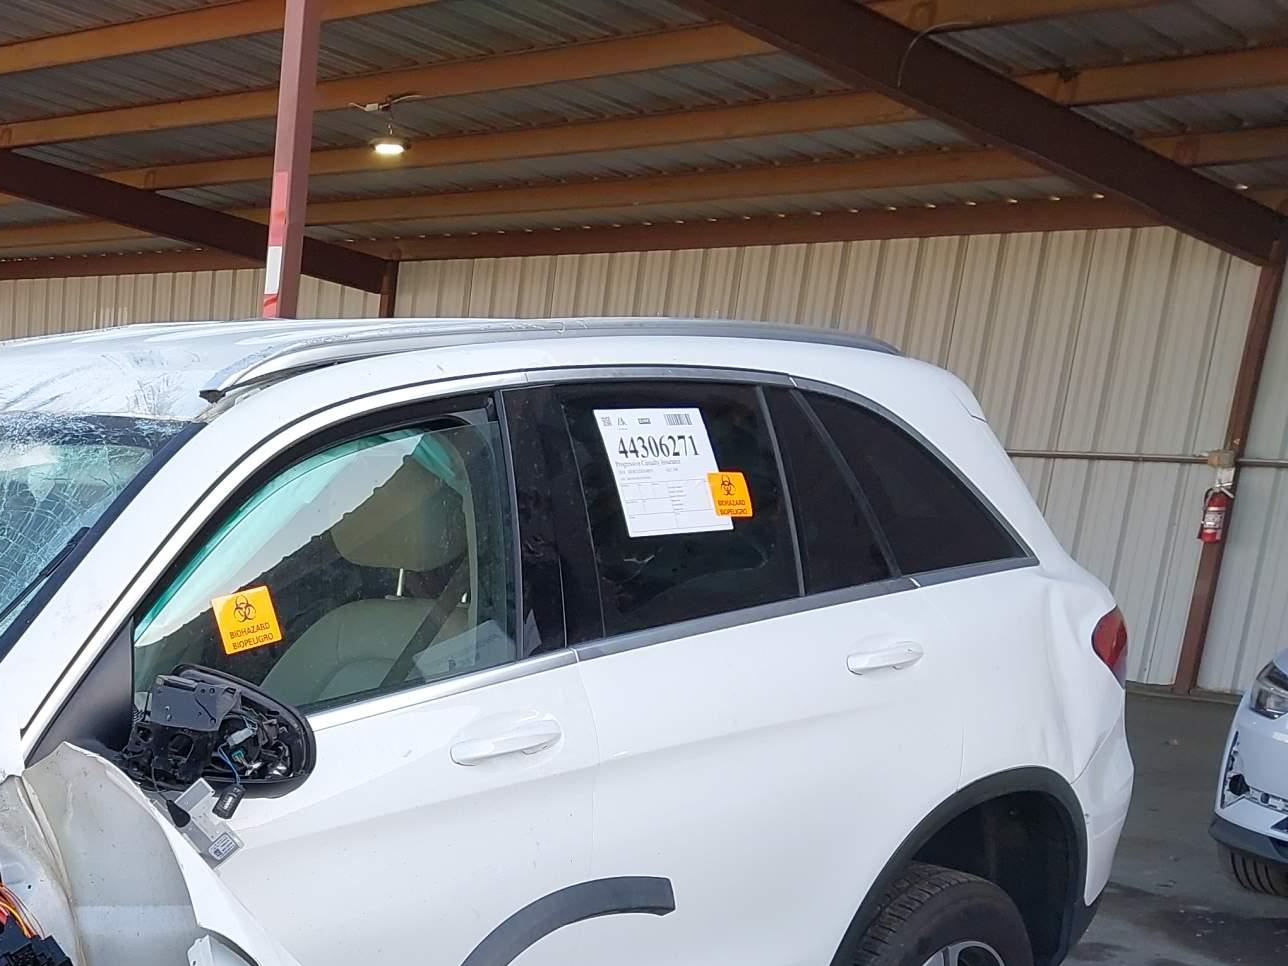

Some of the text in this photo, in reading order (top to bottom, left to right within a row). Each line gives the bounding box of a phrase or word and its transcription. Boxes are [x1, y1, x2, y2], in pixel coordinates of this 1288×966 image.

[618, 435, 699, 459] 44306271
[229, 622, 270, 640] BIOHAZARD
[232, 633, 274, 650] BIOPELIGRO
